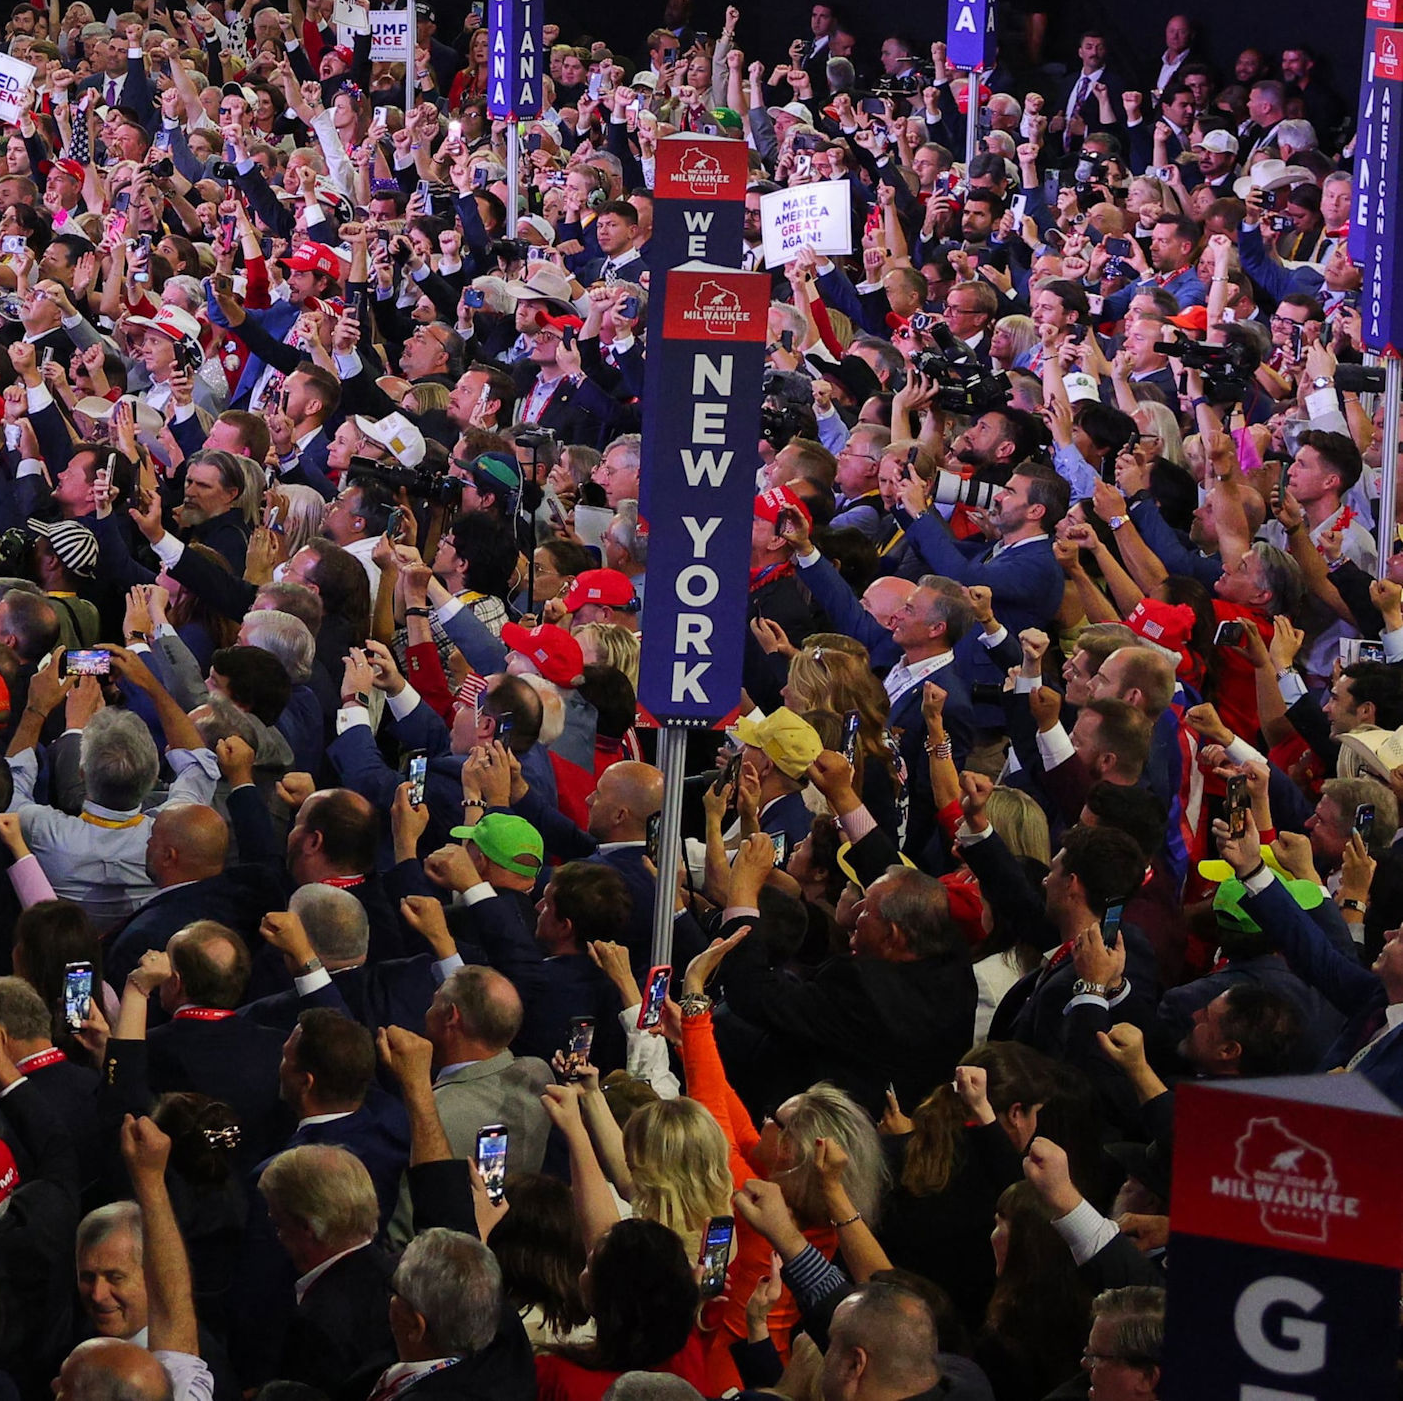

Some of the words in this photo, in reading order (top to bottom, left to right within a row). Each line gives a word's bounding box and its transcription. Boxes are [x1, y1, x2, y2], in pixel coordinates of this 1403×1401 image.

[1376, 86, 1392, 236] AMERICAN
[670, 173, 730, 184] MILWAUKEE
[783, 195, 818, 212] MAKE
[775, 206, 830, 227] AMERICA
[781, 218, 820, 237] GREAT
[782, 232, 822, 251] AGAIN!
[1370, 244, 1383, 338] SAMOA
[683, 310, 750, 322] MILWAUKEE
[680, 353, 735, 487] NEW
[670, 516, 723, 704] YORK
[1211, 1176, 1361, 1217] MILWAUKEE
